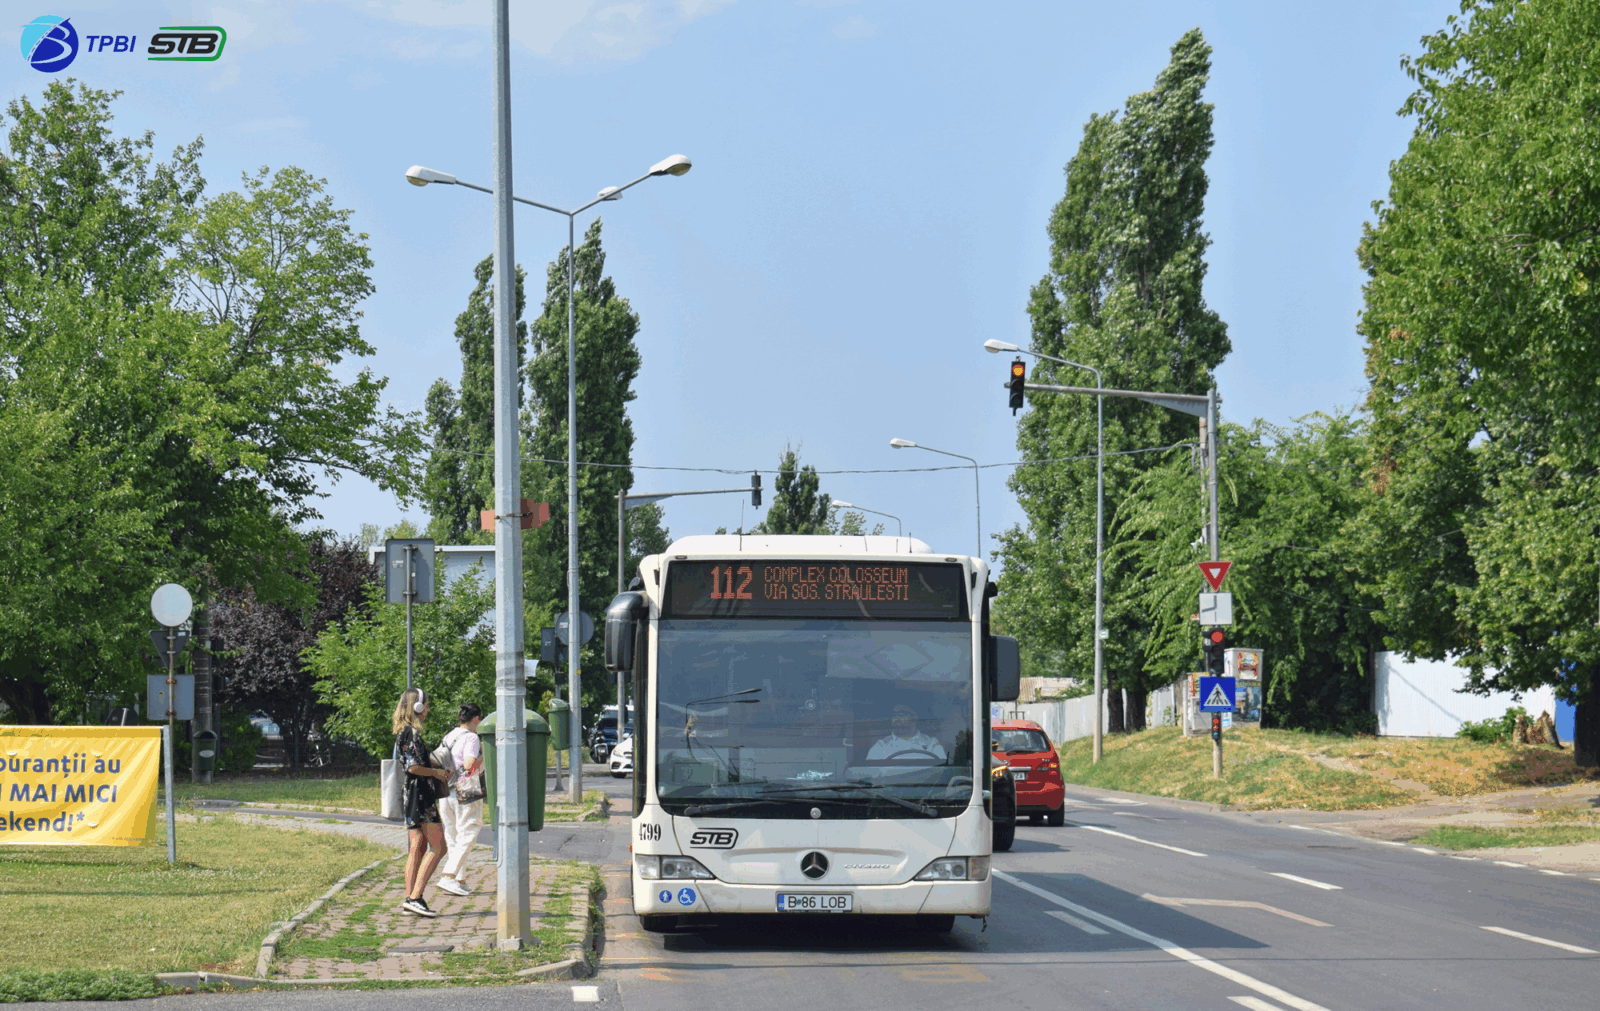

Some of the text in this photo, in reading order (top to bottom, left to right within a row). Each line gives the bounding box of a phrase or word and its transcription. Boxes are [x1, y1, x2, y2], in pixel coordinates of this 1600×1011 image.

[710, 566, 753, 600] 112
[764, 566, 908, 584] COMPLEX COLOSSEUM
[764, 583, 909, 601] VIA SOS. STRAULESTI
[93, 758, 121, 774] au
[9, 783, 58, 803] MAI
[64, 784, 118, 803] MICI
[638, 821, 662, 842] 4799
[689, 831, 734, 845] STB
[788, 895, 798, 909] B
[801, 896, 817, 909] 86
[820, 896, 847, 909] LOB
